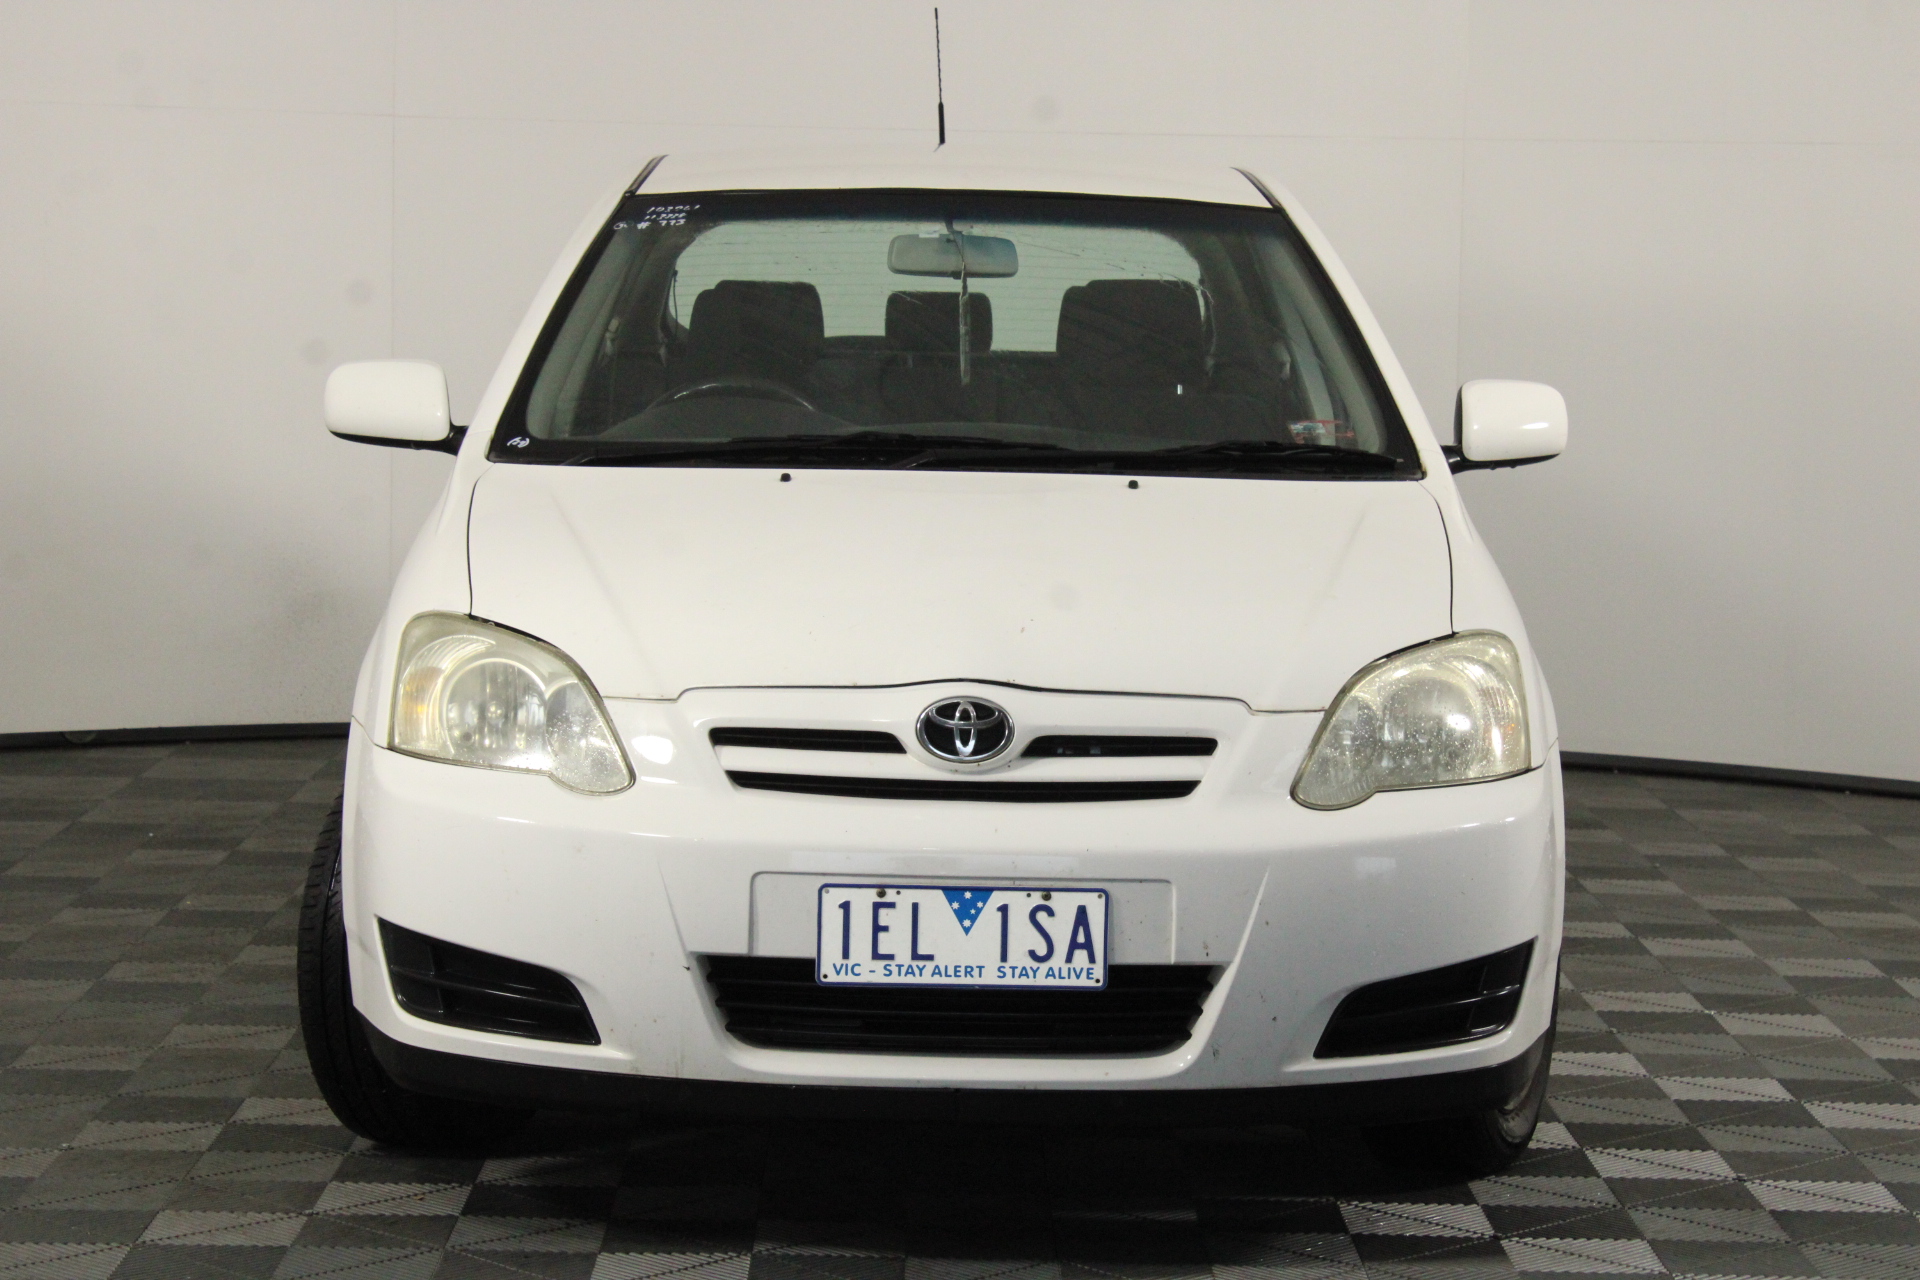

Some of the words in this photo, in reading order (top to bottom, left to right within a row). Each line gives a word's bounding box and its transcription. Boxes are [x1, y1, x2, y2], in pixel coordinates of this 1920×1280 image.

[838, 900, 935, 961] 1EL
[996, 903, 1097, 964] 1SA
[832, 963, 862, 977] VIC
[883, 963, 927, 978] STAY
[931, 964, 986, 979] ALERT
[996, 966, 1041, 980] STAY
[1045, 967, 1095, 981] ALIVE
